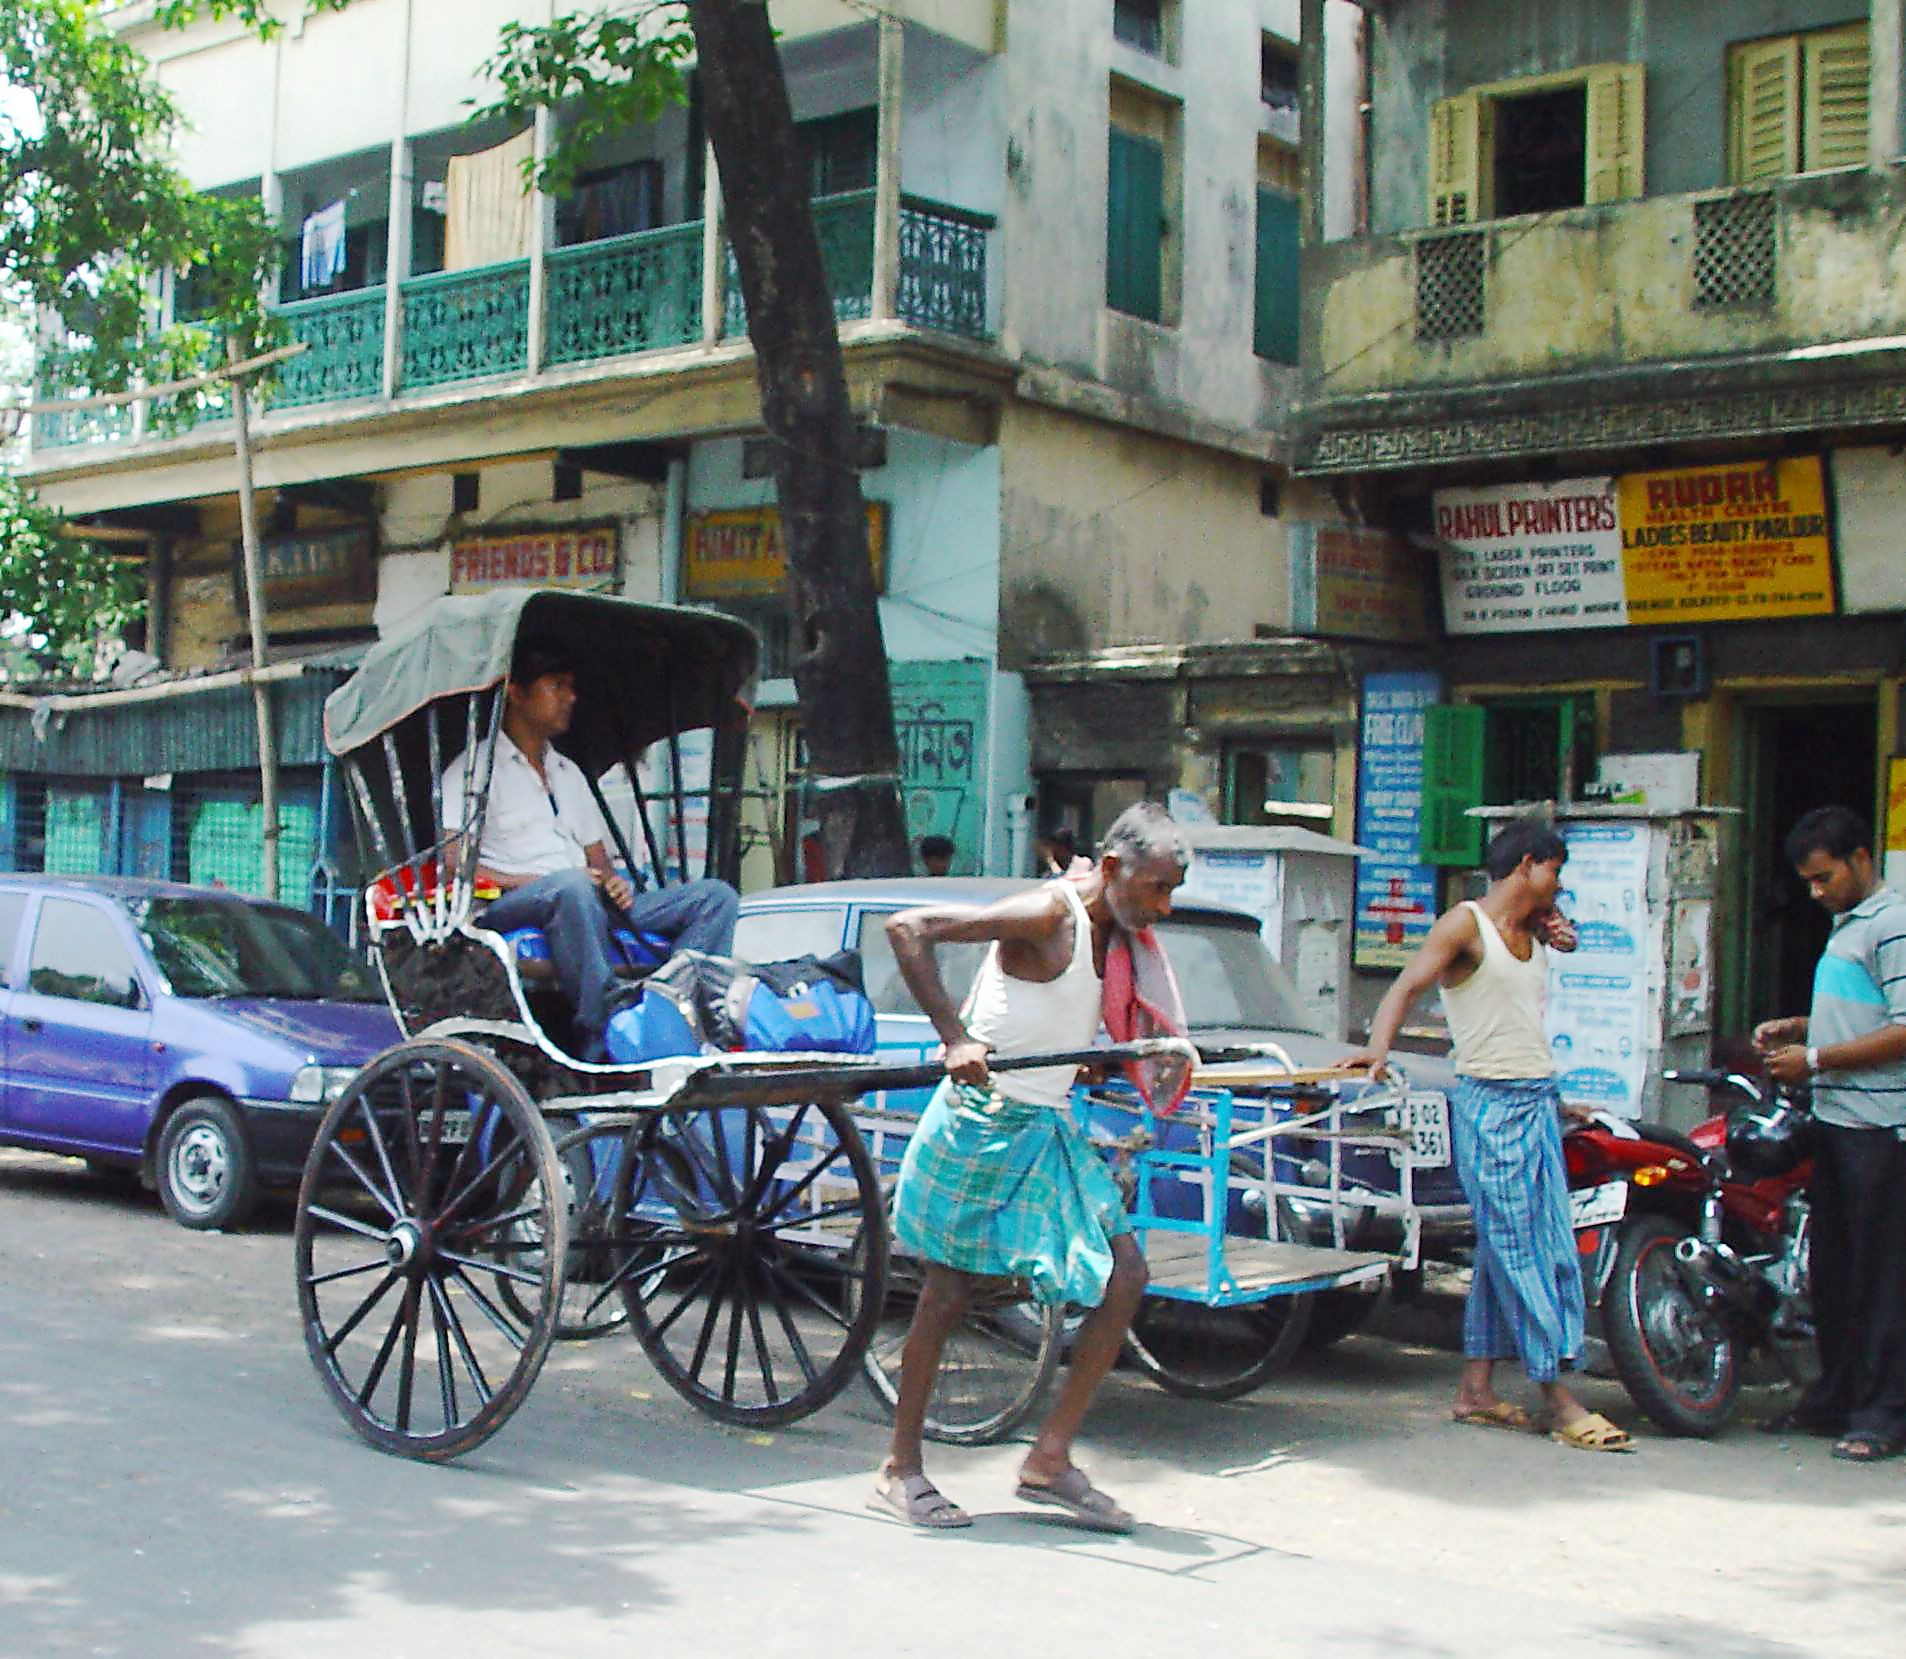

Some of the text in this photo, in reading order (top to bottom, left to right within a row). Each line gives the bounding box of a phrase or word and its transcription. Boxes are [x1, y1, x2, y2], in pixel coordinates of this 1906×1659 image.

[1438, 495, 1616, 540] RAHUL PRINTERS
[1621, 515, 1825, 549] LADIES BEAUTY PARLOUR
[452, 540, 549, 583] FRIENDS
[554, 538, 572, 578] &
[1534, 579, 1582, 595] FLOOR
